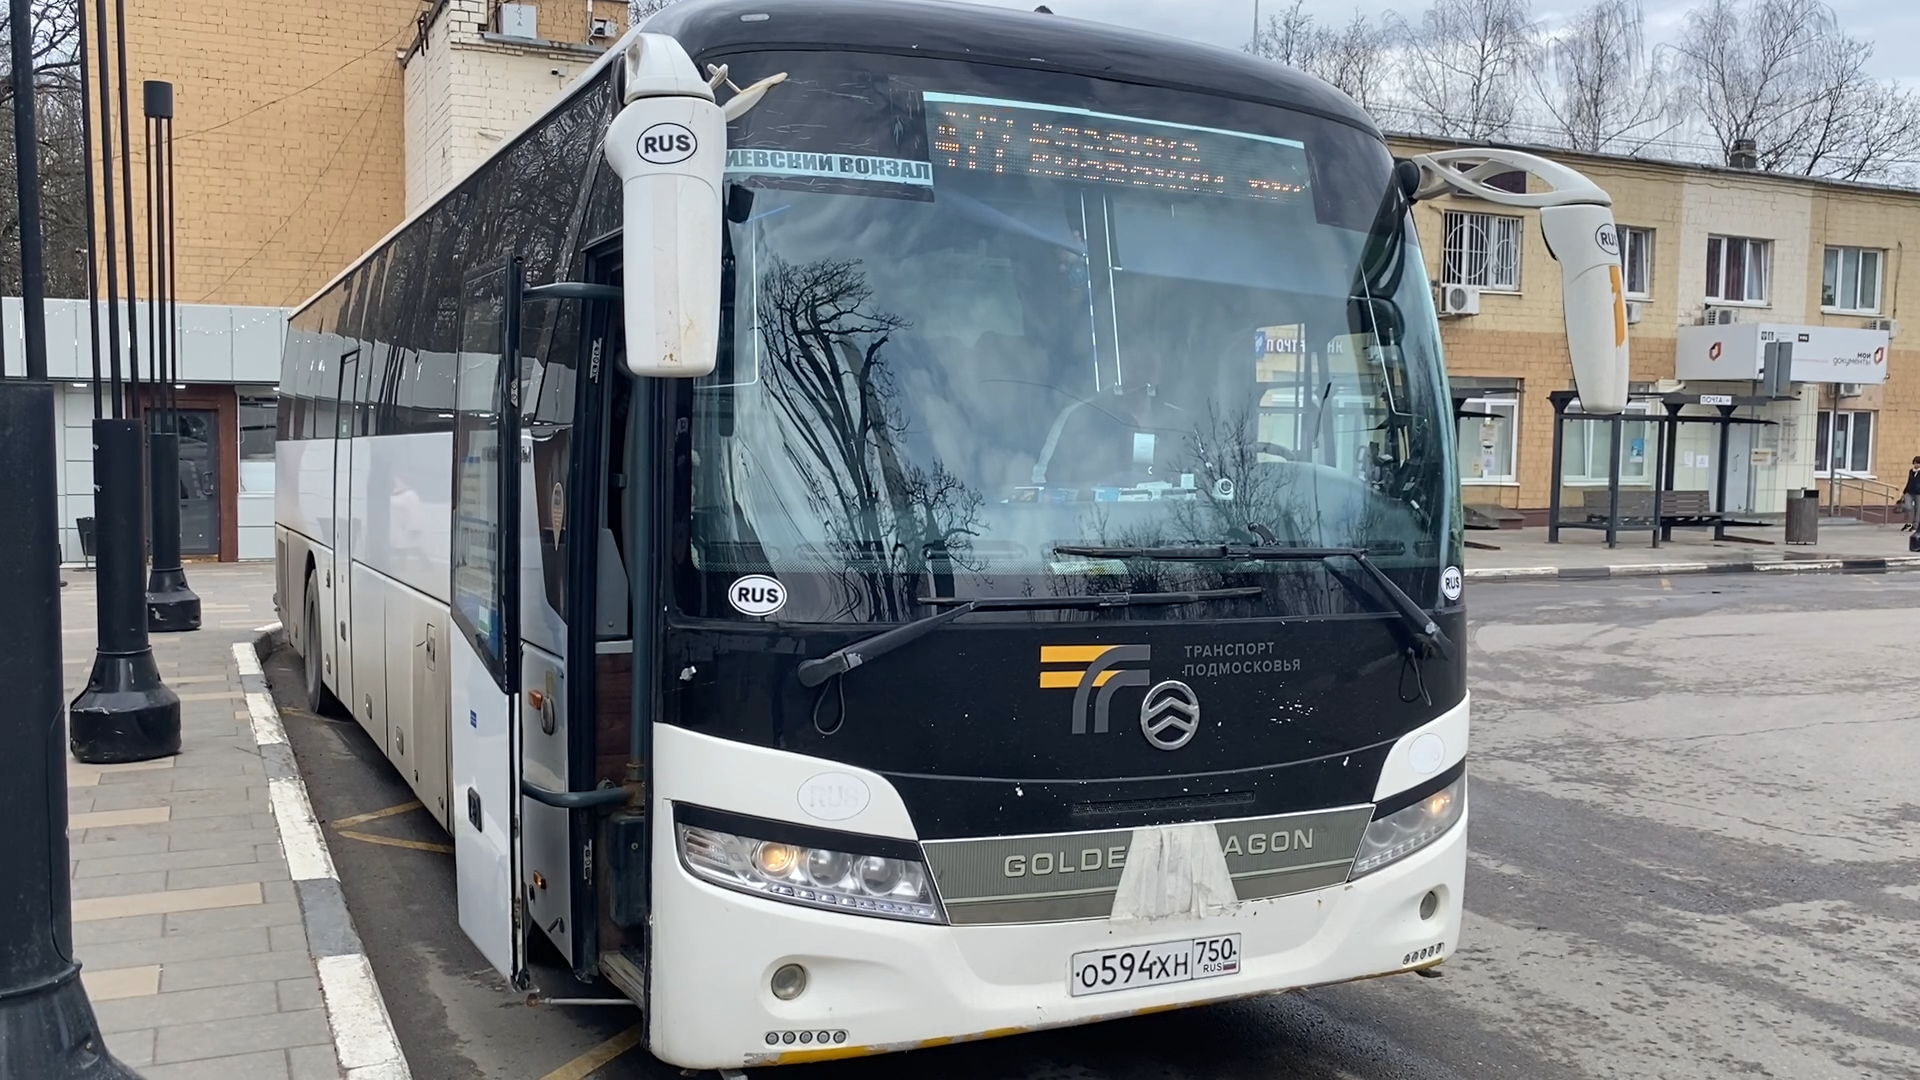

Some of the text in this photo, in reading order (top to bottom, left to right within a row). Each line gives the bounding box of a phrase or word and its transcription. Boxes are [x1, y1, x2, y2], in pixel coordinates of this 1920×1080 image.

[644, 134, 691, 154] RUS
[725, 150, 931, 180] ИЕВСКИЙ ВОКЗАЛ
[1445, 577, 1460, 589] RUS
[738, 587, 779, 603] RUS
[1184, 642, 1275, 658] ТРАНСПОРТ
[1184, 659, 1301, 677] ПОДМОСКОВЬЯ
[1003, 828, 1313, 878] GOLDE AGON
[1195, 938, 1234, 964] 750
[1203, 963, 1223, 973] RUS
